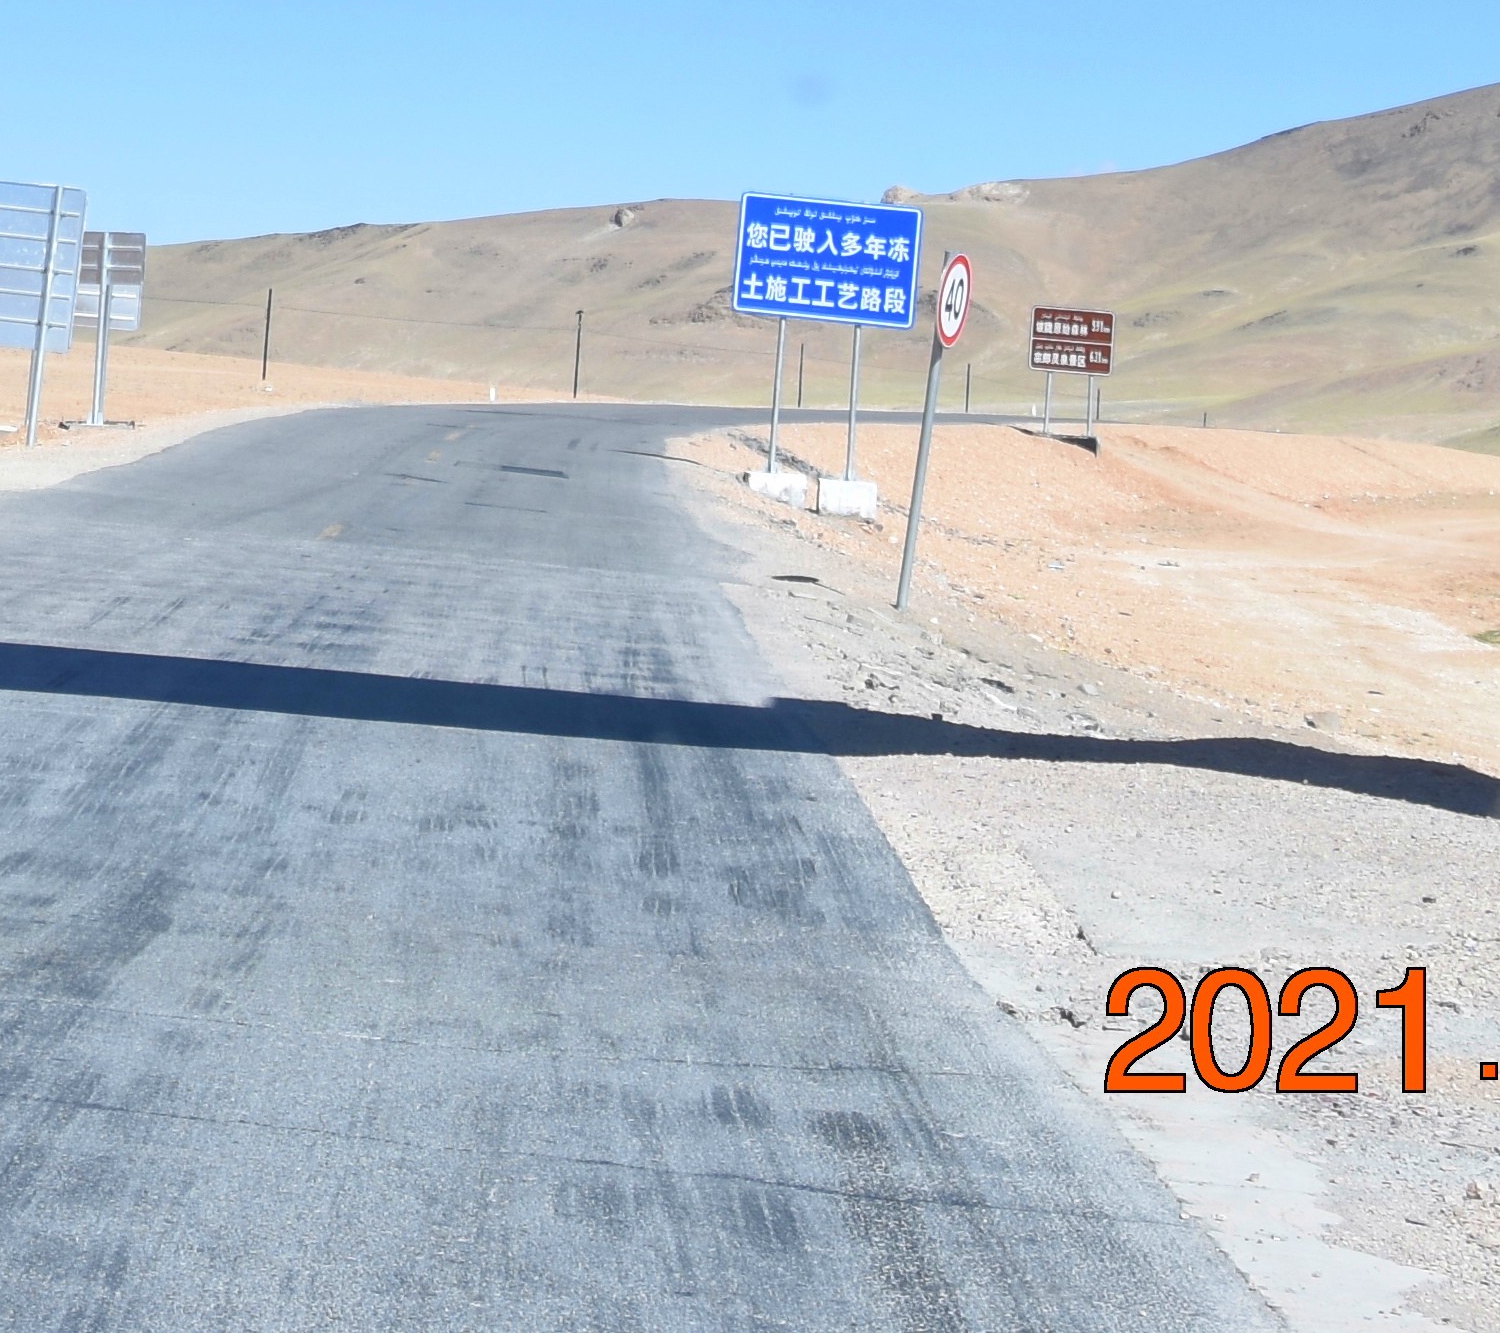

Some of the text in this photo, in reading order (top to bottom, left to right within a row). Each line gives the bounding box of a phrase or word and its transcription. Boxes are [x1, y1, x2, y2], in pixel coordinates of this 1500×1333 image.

[746, 222, 910, 263] 您已驶入多年冻
[740, 272, 906, 315] 土施工工艺路段
[944, 277, 966, 321] 40
